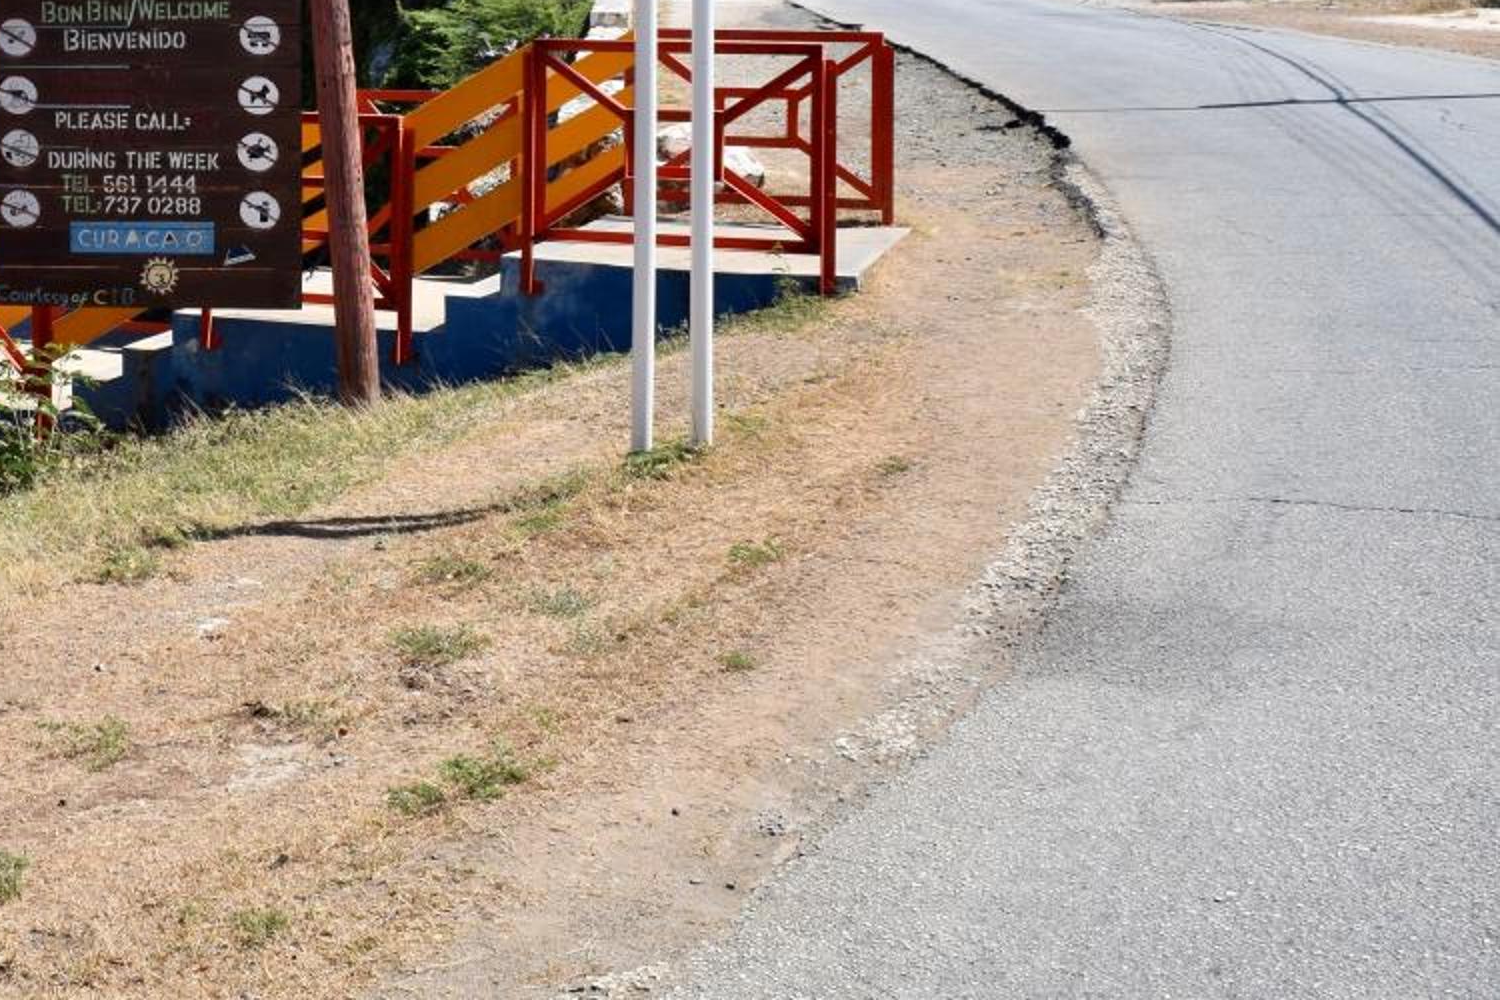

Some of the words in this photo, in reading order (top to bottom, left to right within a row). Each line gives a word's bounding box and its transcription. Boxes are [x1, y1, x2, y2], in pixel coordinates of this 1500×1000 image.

[63, 28, 186, 51] BIENVENIDO
[55, 111, 129, 130] PLEASE
[48, 147, 116, 169] DURING
[126, 151, 161, 169] THE
[169, 152, 220, 171] WEEK
[103, 175, 136, 193] 561
[147, 175, 196, 194] 1444
[103, 196, 142, 214] 737
[147, 196, 201, 215] 0288
